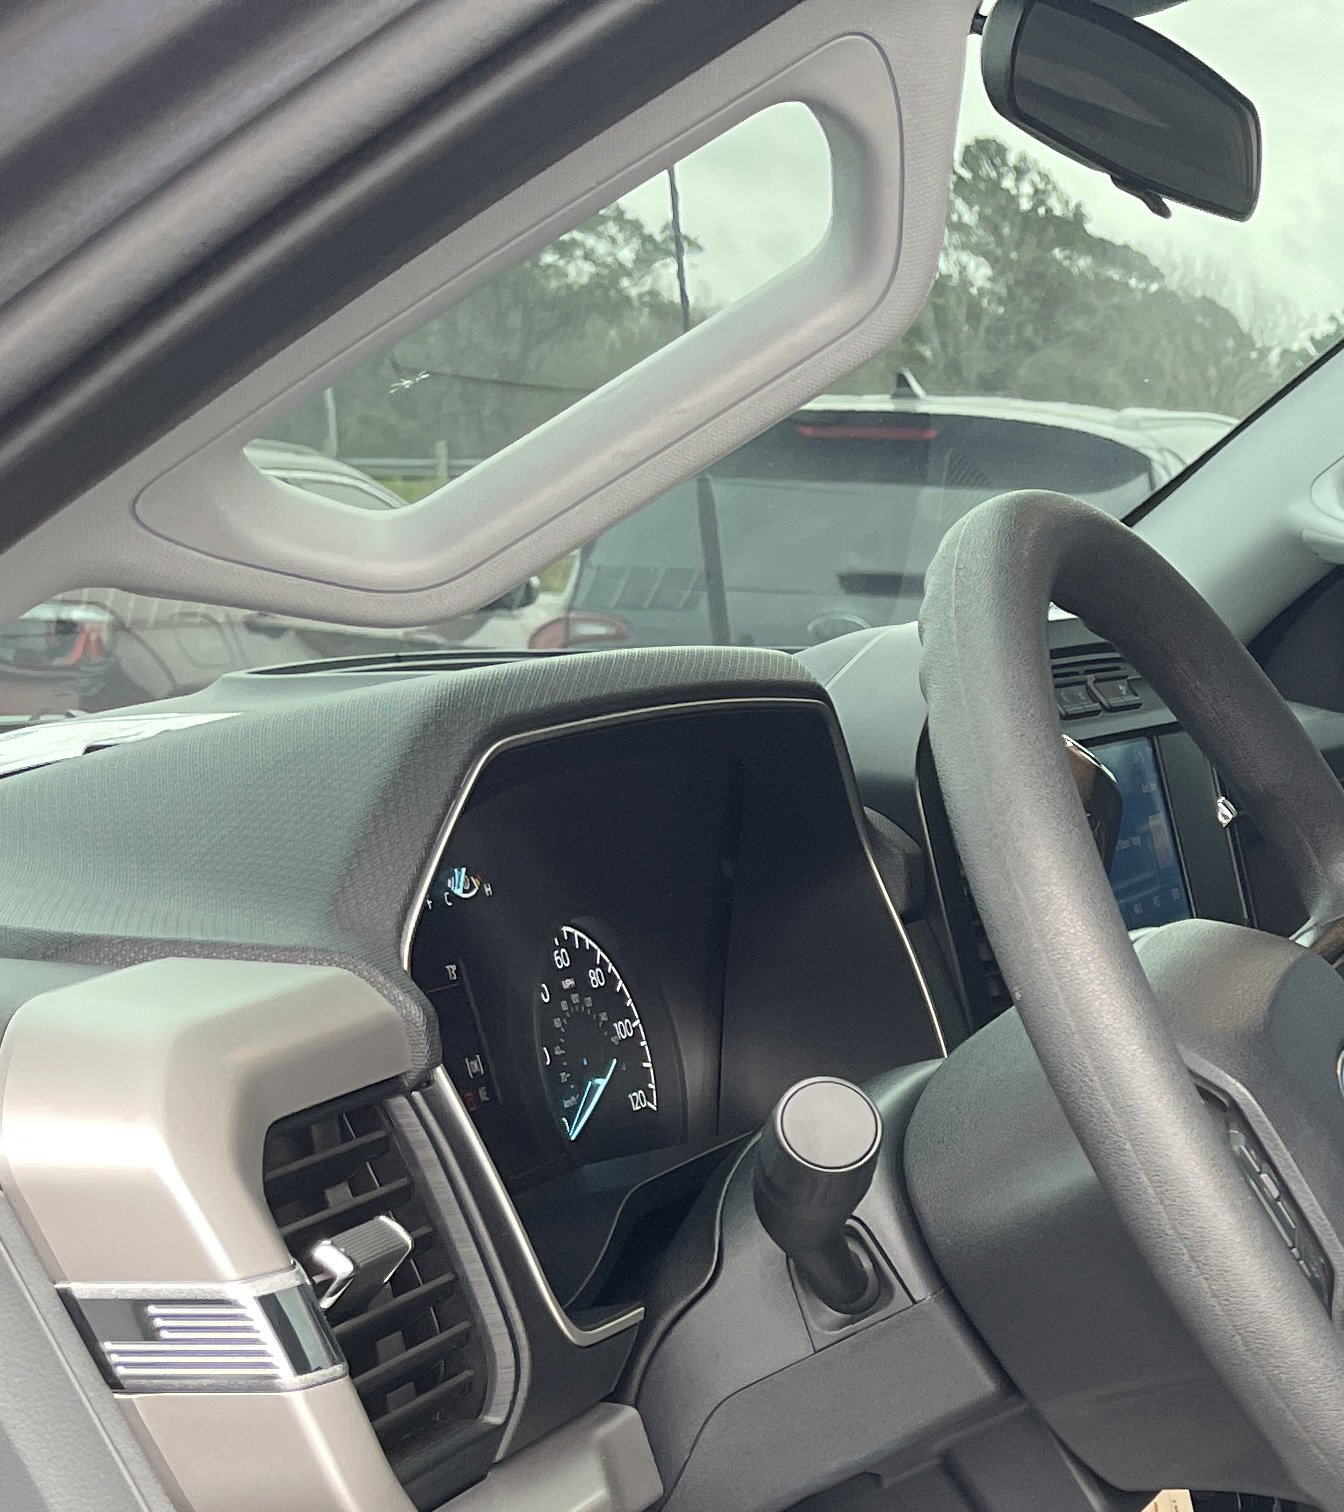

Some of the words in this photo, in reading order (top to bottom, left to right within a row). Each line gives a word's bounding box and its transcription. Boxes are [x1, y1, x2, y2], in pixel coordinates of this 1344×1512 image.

[553, 948, 571, 969] 60
[588, 968, 606, 988] 80
[613, 1018, 634, 1040] 100
[628, 1089, 648, 1112] 120
